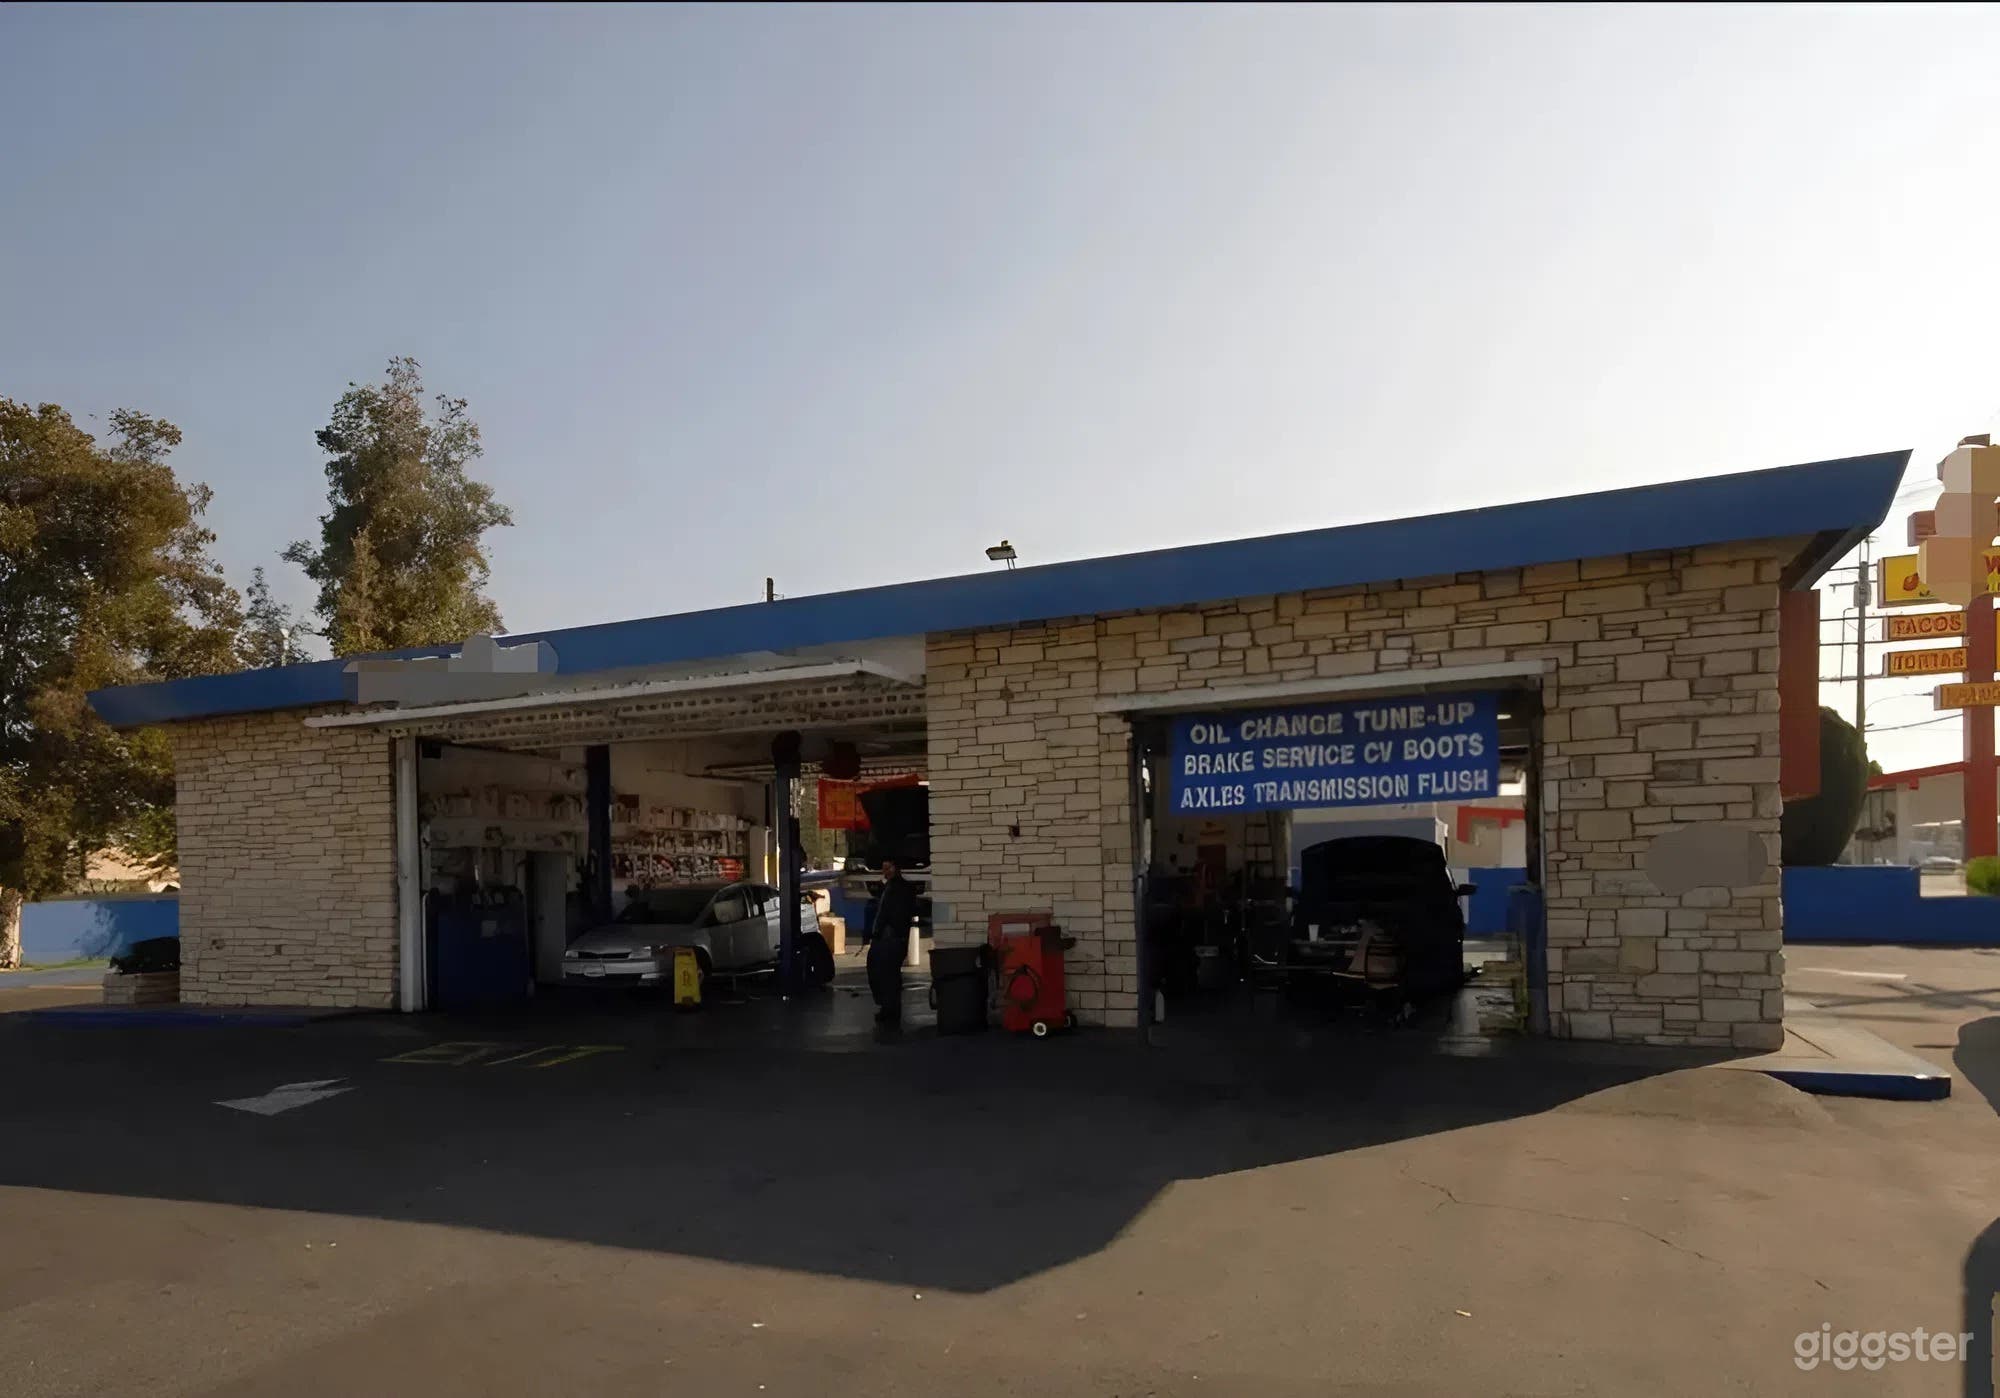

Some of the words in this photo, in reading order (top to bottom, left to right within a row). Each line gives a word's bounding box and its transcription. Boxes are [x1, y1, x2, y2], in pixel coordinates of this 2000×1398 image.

[1894, 613, 1962, 634] TACOS
[1190, 723, 1231, 745] OIL
[1240, 712, 1344, 741] CHANGE
[1353, 702, 1475, 733] TUNE-UP
[1184, 751, 1255, 776] BRAKE
[1262, 744, 1356, 769] SERVICE
[1363, 740, 1394, 764] CV
[1403, 732, 1485, 761] BOOTS
[1180, 784, 1246, 809] AXLES
[1253, 773, 1409, 804] TRANSMISSION
[1417, 768, 1489, 795] FLUSH
